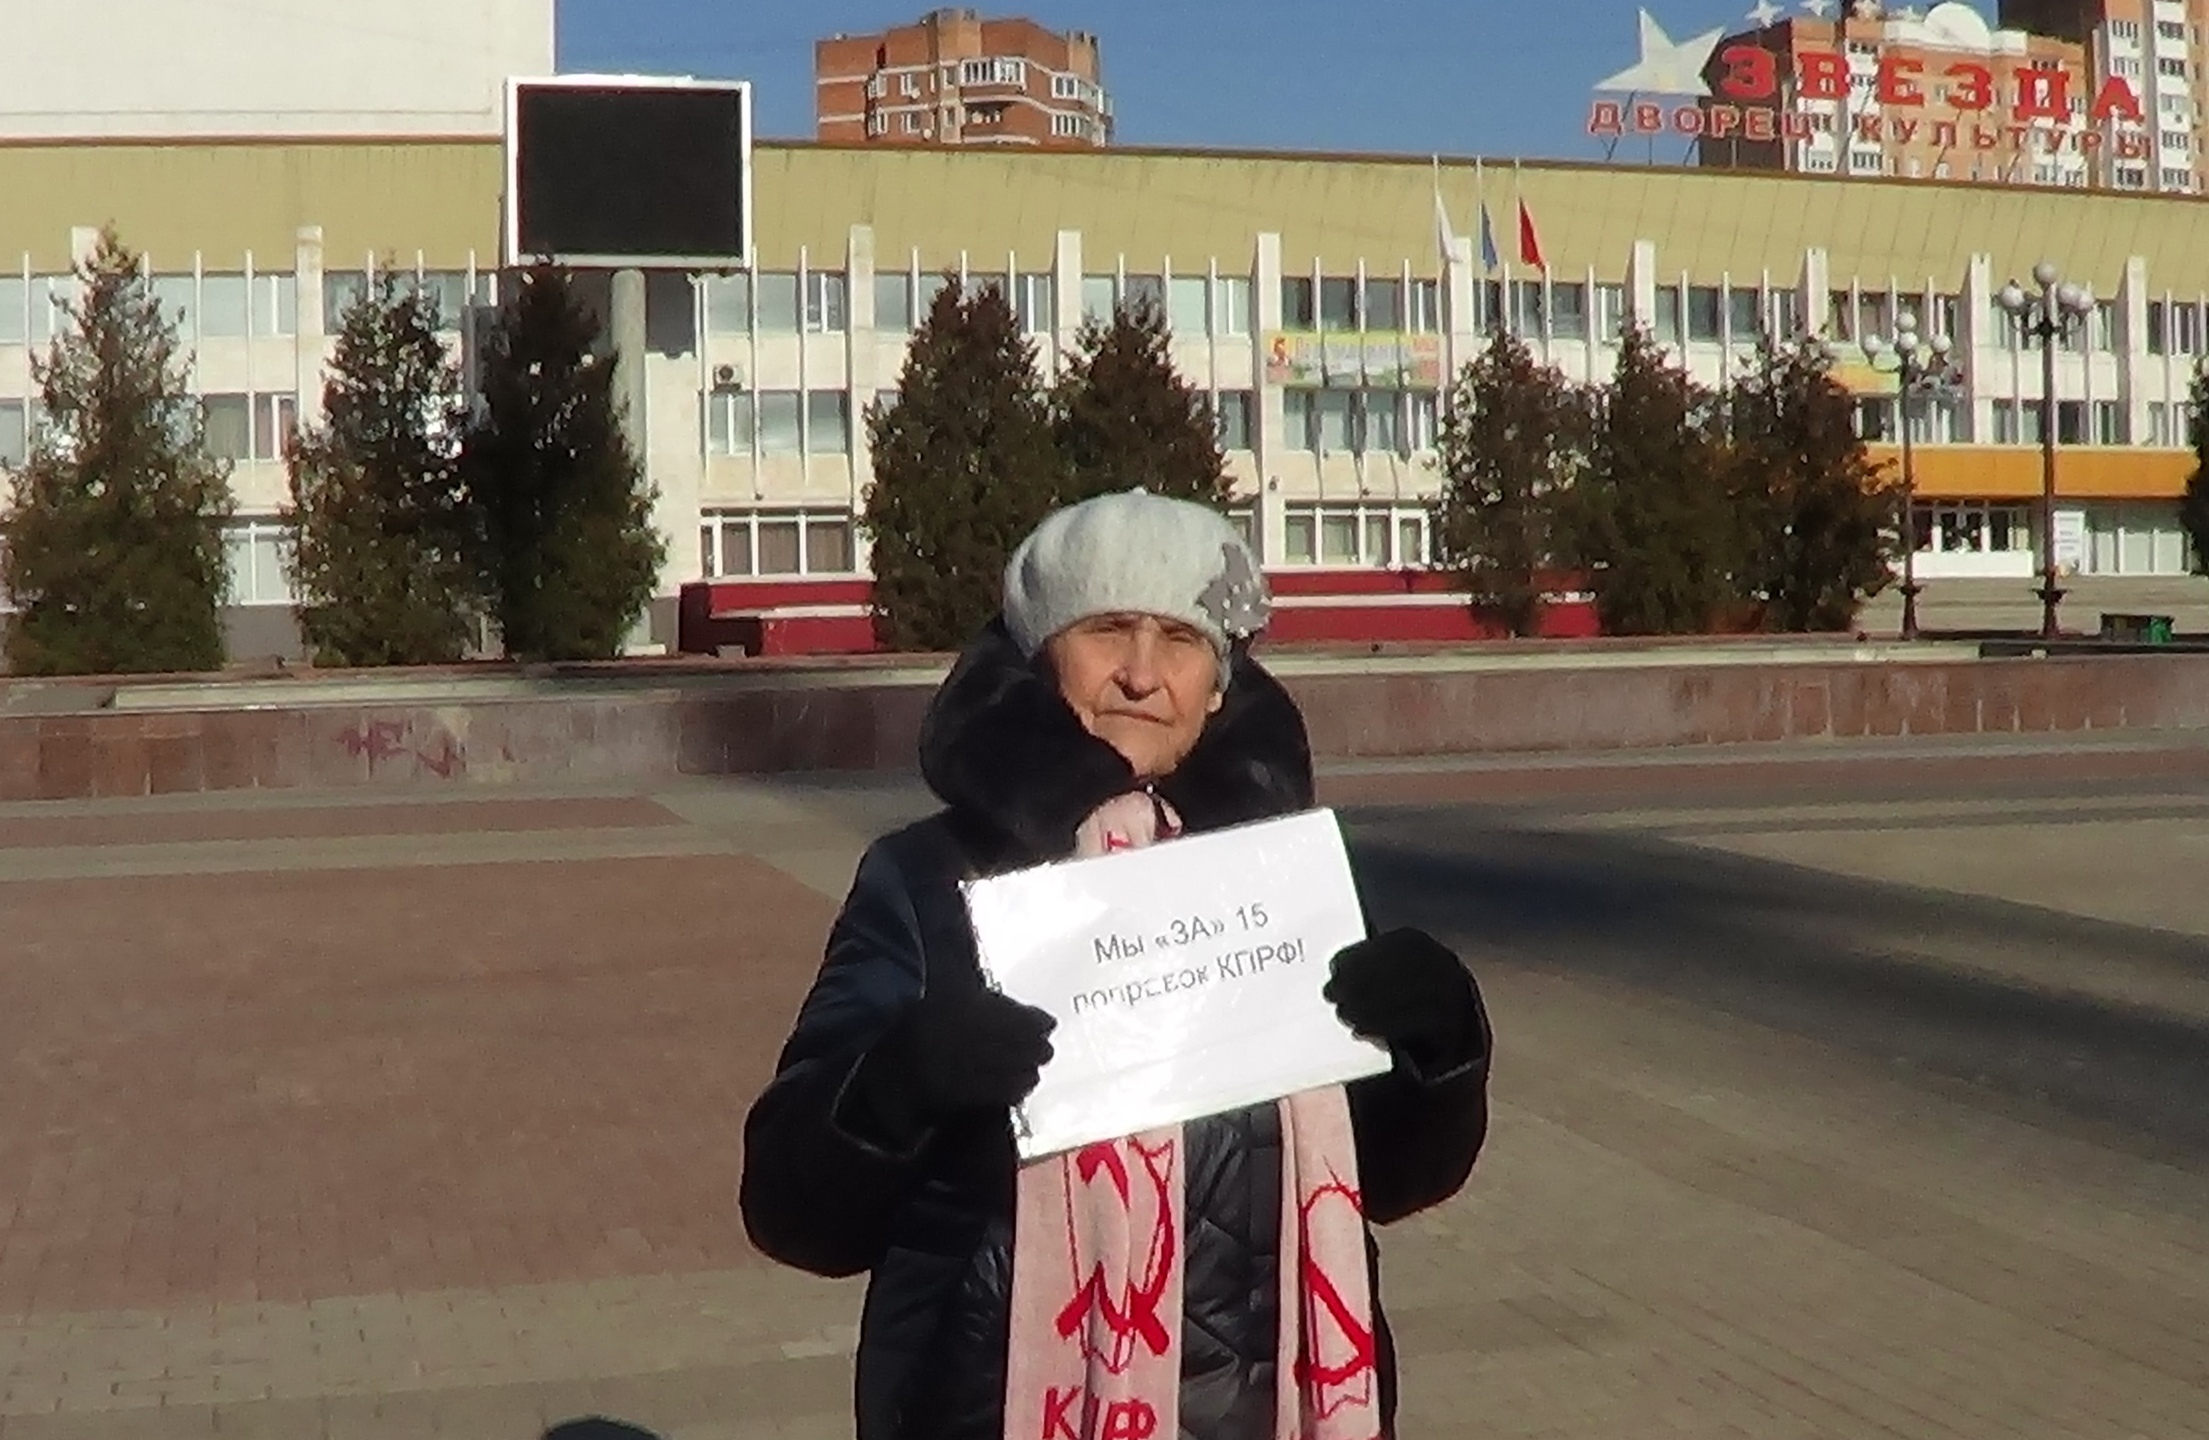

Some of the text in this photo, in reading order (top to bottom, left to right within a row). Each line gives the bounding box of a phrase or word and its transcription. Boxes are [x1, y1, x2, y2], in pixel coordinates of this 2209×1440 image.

[1720, 44, 2144, 123] ЗВЕЗДА
[1587, 102, 2151, 159] ДВОРЕЦ КУЛЬТУРЫ
[1092, 901, 1269, 964] Мы «ЗА» 15
[1216, 938, 1306, 979] КПРФ!
